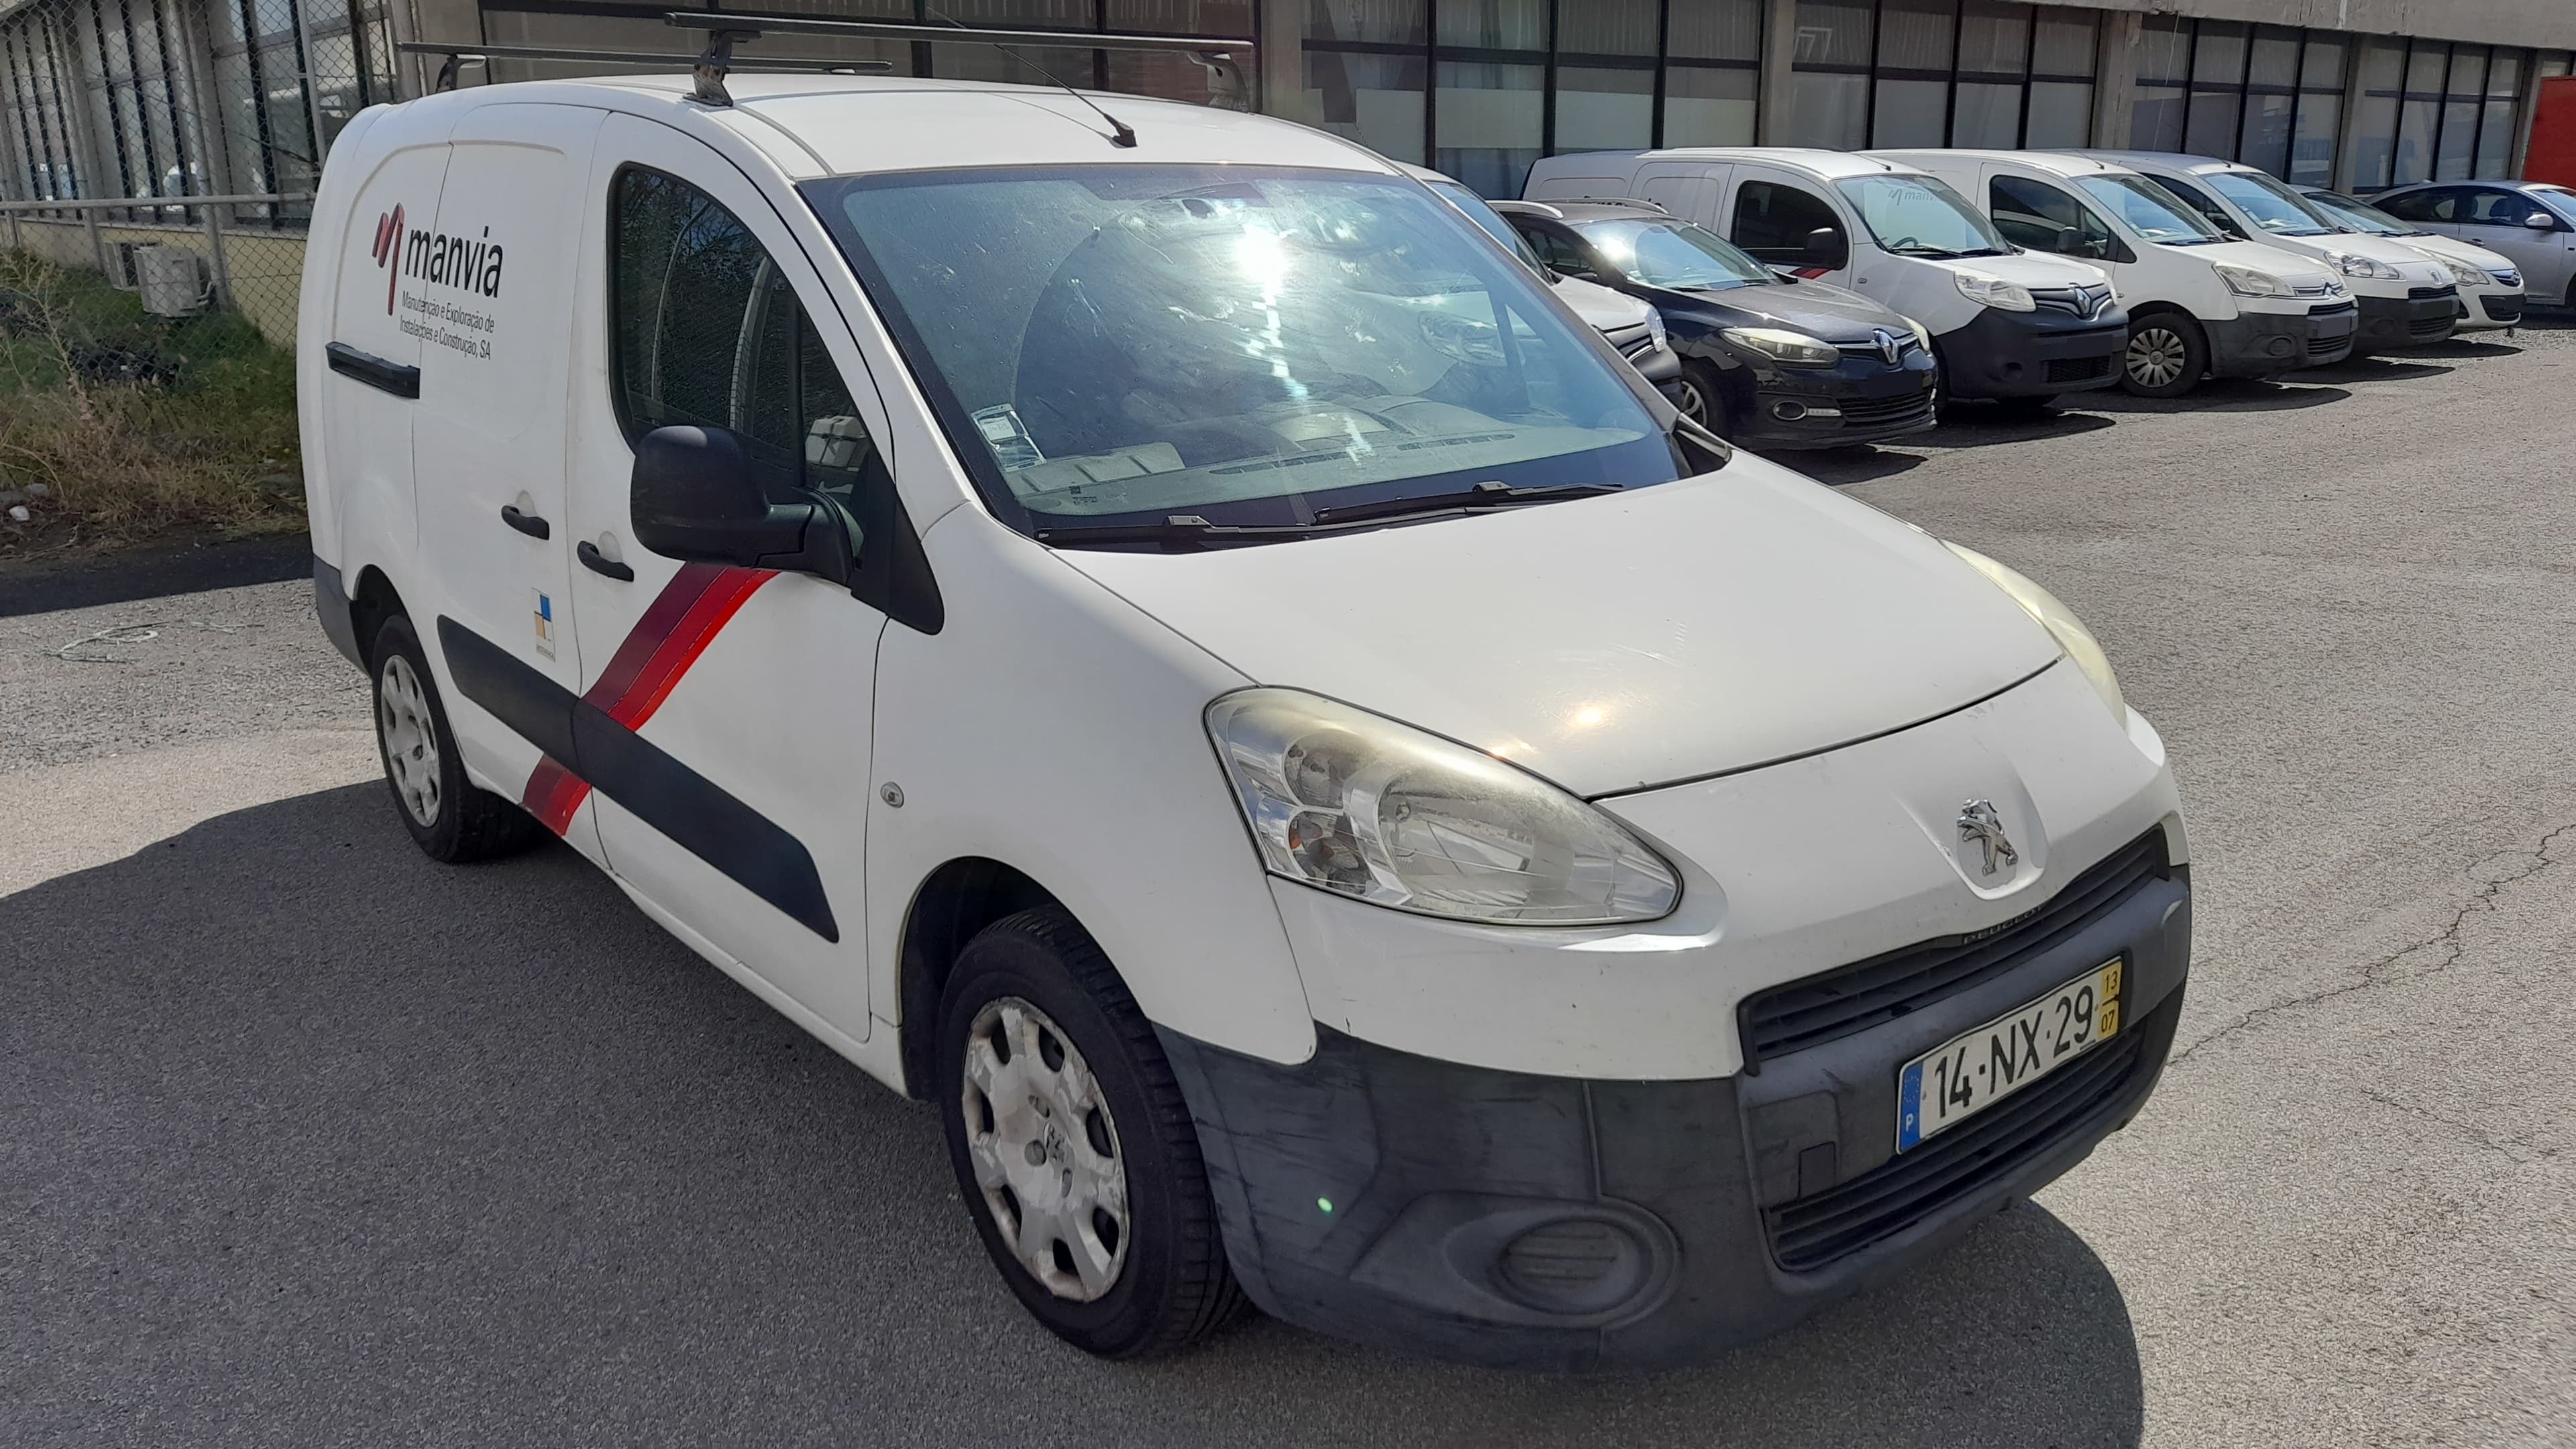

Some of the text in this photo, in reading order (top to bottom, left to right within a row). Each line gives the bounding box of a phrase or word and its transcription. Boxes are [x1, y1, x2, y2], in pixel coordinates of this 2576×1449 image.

[405, 225, 502, 298] manvia
[402, 290, 494, 333] Manutenção e Exploração de
[400, 314, 490, 360] Instalações e Construção, SA
[2104, 971, 2118, 994] 13
[2101, 1009, 2115, 1033] 07
[1906, 1113, 1913, 1132] P
